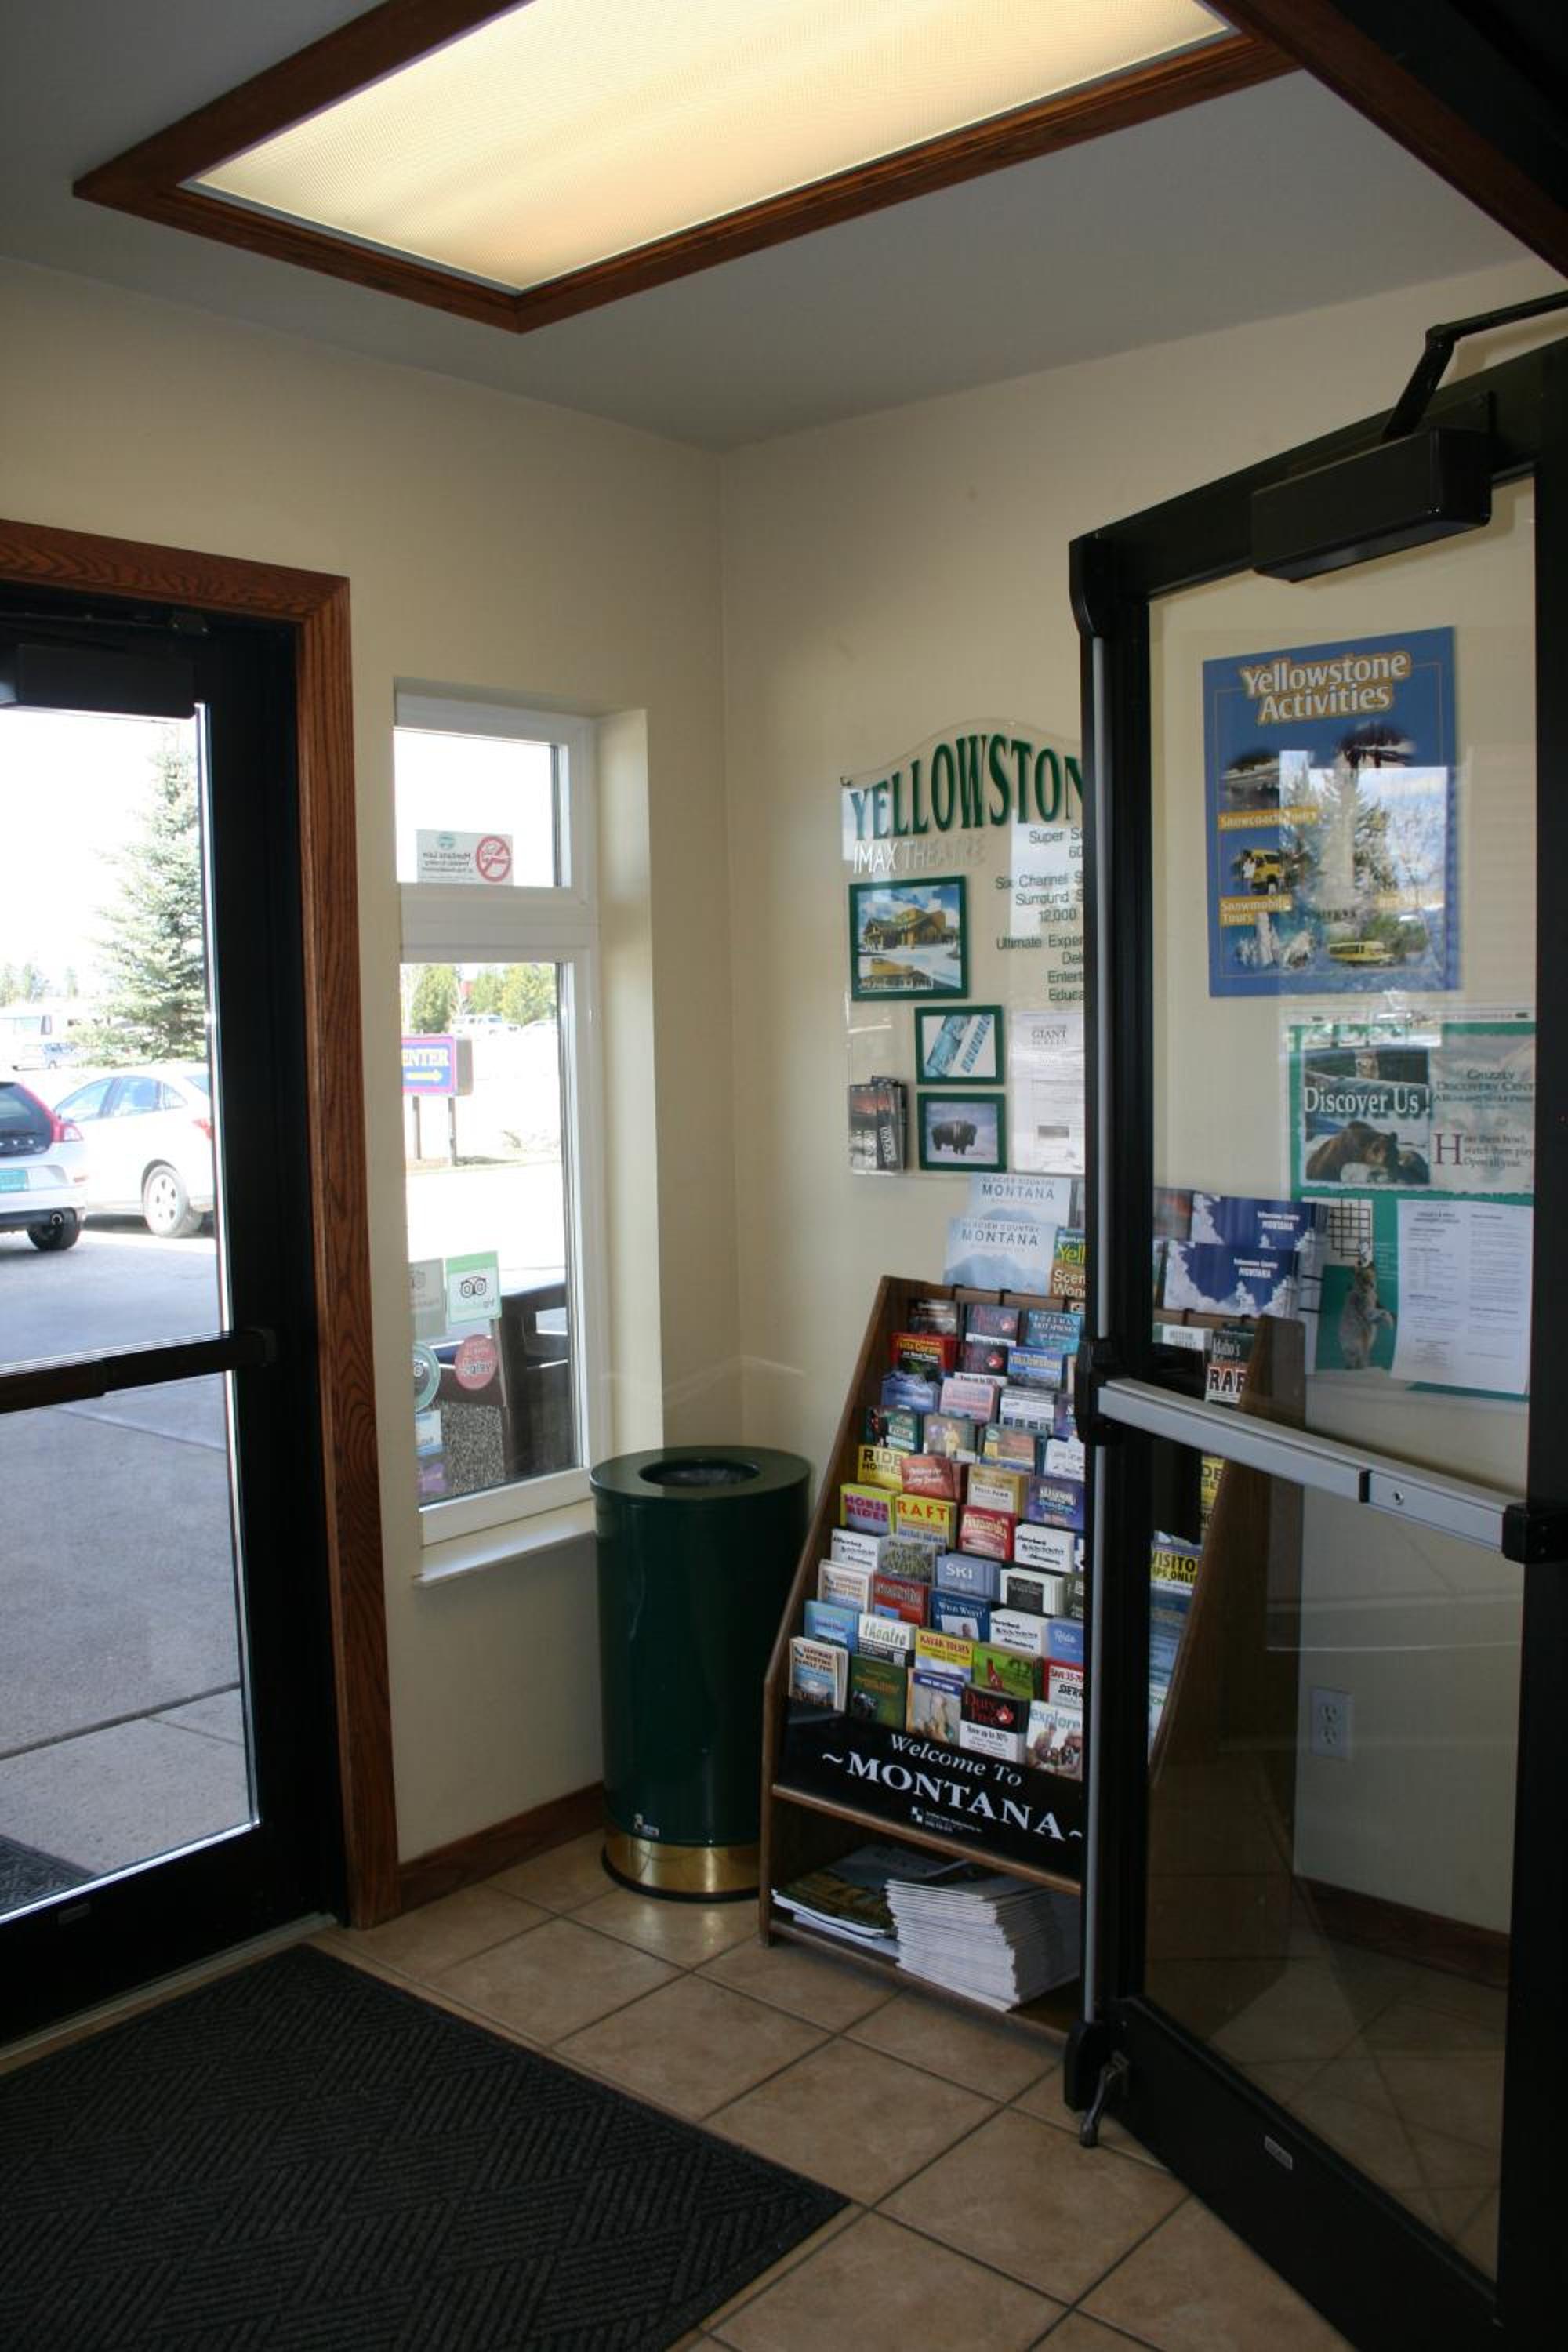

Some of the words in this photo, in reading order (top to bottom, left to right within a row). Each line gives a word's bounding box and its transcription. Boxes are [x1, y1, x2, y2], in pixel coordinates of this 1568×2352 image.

[1240, 653, 1408, 697] Yellowstone
[1260, 682, 1392, 723] Activities
[1029, 829, 1065, 844] Super
[854, 840, 898, 874] IMAX
[1018, 873, 1069, 888] Channel
[1015, 891, 1069, 906] Surround
[996, 936, 1042, 951] Ultimate
[1304, 1086, 1388, 1114] Discover
[1393, 1087, 1421, 1114] Us
[982, 1184, 1054, 1200] MONTANA
[961, 1229, 1039, 1247] MONTANA
[863, 1448, 903, 1468] RIDE
[898, 1500, 946, 1521] RAFT
[946, 1563, 973, 1580] SKI
[891, 1733, 986, 1776] Welcome
[993, 1762, 1022, 1787] To
